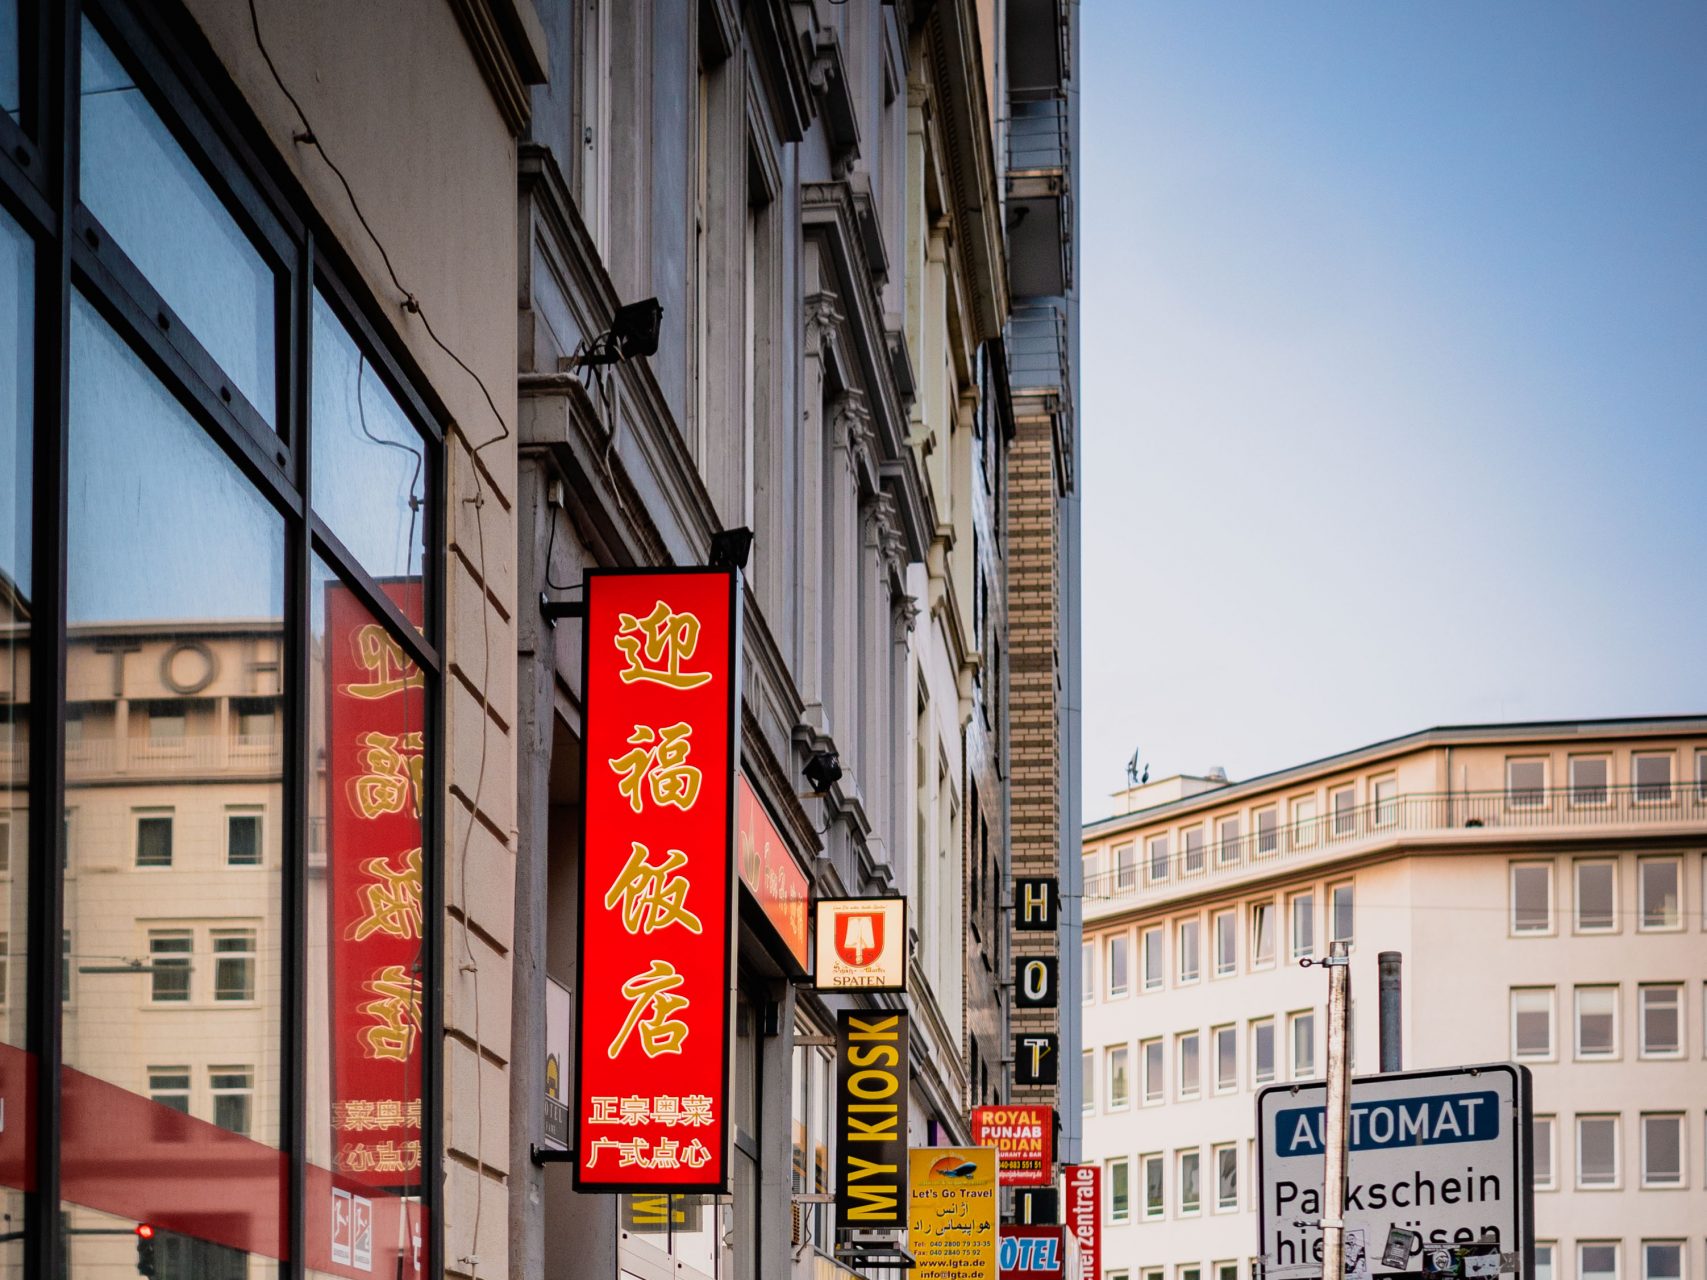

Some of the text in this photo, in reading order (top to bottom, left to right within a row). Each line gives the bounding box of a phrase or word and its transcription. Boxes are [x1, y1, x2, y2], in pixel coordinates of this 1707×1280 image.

[605, 600, 712, 1061] 迎福饭店
[833, 976, 885, 986] SPATEN
[847, 1015, 899, 1140] KIOSK
[544, 1101, 563, 1124] OTEL
[588, 1094, 714, 1128] 正宗粤菜
[982, 1111, 1042, 1125] ROYAL
[1290, 1098, 1484, 1151] ATOMAT
[981, 1126, 1042, 1138] PUNJAB
[586, 1137, 712, 1169] 广式点心
[847, 1155, 899, 1221] MY
[912, 1188, 993, 1198] Let's Go Travel
[1276, 1166, 1501, 1217] Pakschein
[919, 1259, 986, 1268] www.lgta.de
[999, 1235, 1061, 1272] OTEL
[920, 1271, 984, 1280] info@lgta.de
